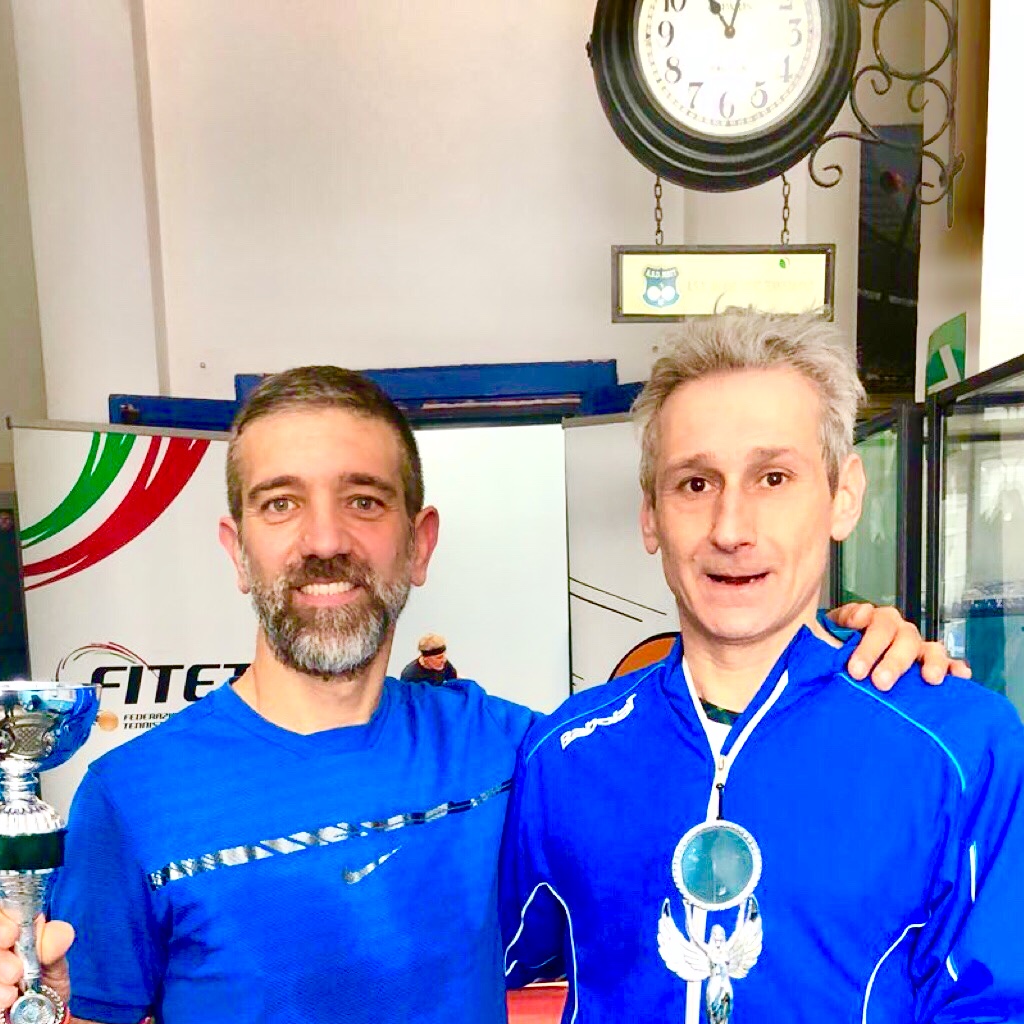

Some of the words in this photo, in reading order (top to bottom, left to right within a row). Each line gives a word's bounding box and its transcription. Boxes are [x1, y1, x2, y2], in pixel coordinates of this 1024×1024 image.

[658, 20, 674, 48] 9
[665, 56, 682, 84] 8
[688, 81, 704, 109] 7
[719, 91, 735, 119] 6
[751, 80, 768, 109] 5
